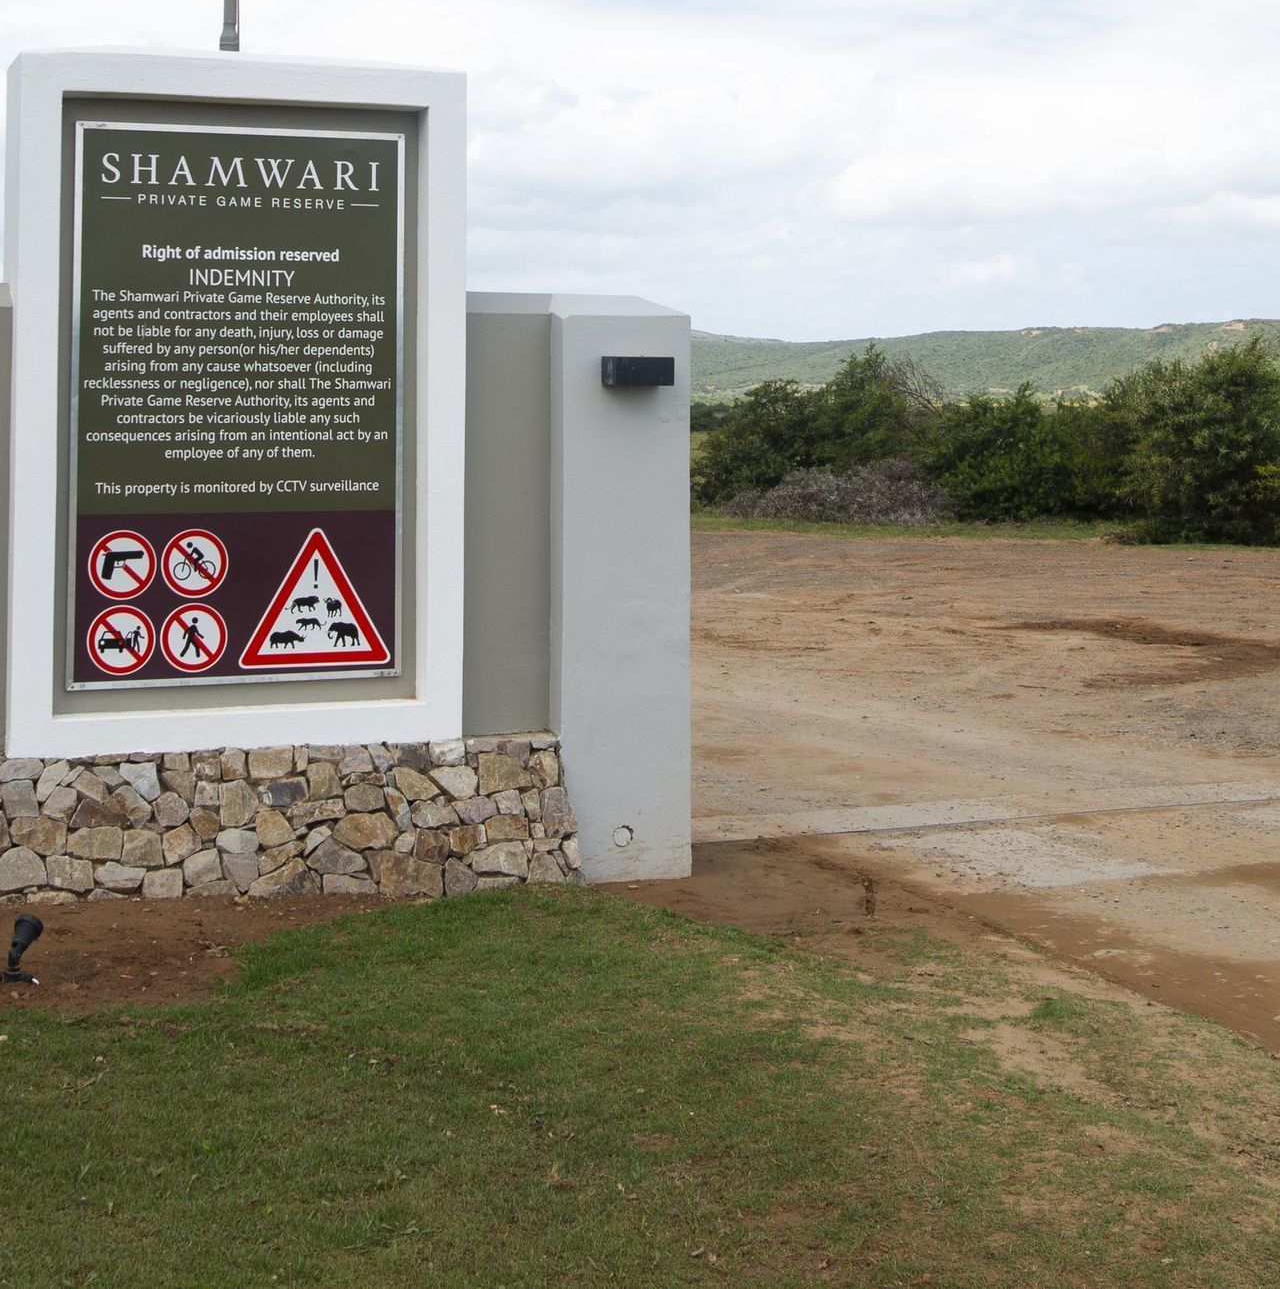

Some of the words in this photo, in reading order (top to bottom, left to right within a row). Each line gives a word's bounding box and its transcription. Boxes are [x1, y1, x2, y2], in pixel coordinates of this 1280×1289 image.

[101, 152, 380, 191] SHAMWARI
[138, 193, 207, 206] PRIVATE
[216, 196, 262, 208] GAME
[272, 197, 344, 210] RESERVE
[142, 244, 182, 262] Right
[185, 245, 201, 259] of
[203, 246, 276, 261] admission
[280, 248, 339, 262] reserved
[190, 268, 295, 287] INDEMNITY
[92, 289, 116, 302] The
[119, 289, 179, 302] Shamwari
[183, 291, 225, 303] Private
[228, 291, 262, 304] Game
[266, 292, 311, 304] Reserve
[313, 293, 369, 308] Authority,
[372, 294, 385, 305] its
[93, 309, 134, 322] agents
[137, 308, 160, 320] and
[164, 309, 231, 320] contractors
[234, 309, 257, 321] and
[260, 309, 288, 321] their
[291, 310, 353, 324] employees
[357, 310, 385, 322] shall
[94, 326, 114, 336] not
[118, 325, 133, 337] be
[137, 325, 171, 337] liable
[174, 325, 192, 337] for
[195, 328, 217, 340] any
[219, 326, 257, 339] death,
[259, 326, 294, 341] injury,
[296, 327, 319, 338] loss
[322, 329, 335, 338] or
[338, 327, 384, 342] damage
[103, 342, 153, 354] suffered
[157, 343, 171, 357] by
[173, 345, 196, 357] any
[199, 343, 255, 357] person(or
[259, 343, 300, 357] his/her
[303, 344, 375, 358] dependents)
[104, 359, 146, 374] arising
[150, 360, 178, 372] from
[182, 363, 204, 374] any
[206, 363, 241, 372] cause
[244, 360, 312, 372] whatsoever
[315, 361, 372, 375] (including
[84, 377, 160, 389] recklessness
[163, 380, 177, 389] or
[180, 377, 252, 392] negligence),
[255, 380, 275, 389] nor
[278, 378, 306, 389] shall
[309, 377, 331, 390] The
[335, 377, 391, 390] Shamwari
[101, 394, 143, 406] Private
[147, 394, 182, 406] Game
[186, 394, 232, 407] Reserve
[234, 395, 292, 409] Authority,
[294, 395, 308, 407] its
[311, 396, 350, 409] agents
[353, 395, 375, 406] and
[116, 413, 185, 424] contractors
[189, 412, 203, 424] be
[206, 412, 271, 426] vicariously
[274, 412, 307, 424] liable
[310, 414, 331, 426] any
[333, 412, 360, 423] such
[86, 432, 171, 444] consequences
[175, 429, 215, 444] arising
[219, 429, 247, 441] from
[251, 432, 265, 441] an
[269, 429, 333, 441] intentional
[336, 430, 354, 440] act
[358, 429, 371, 443] by
[374, 431, 388, 440] an
[165, 447, 224, 461] employee
[227, 446, 240, 458] of
[242, 449, 264, 461] any
[266, 446, 279, 458] of
[281, 446, 315, 458] them.
[95, 482, 121, 494] This
[125, 483, 178, 497] property
[180, 481, 190, 493] is
[194, 481, 256, 493] monitored
[259, 481, 274, 495] by
[276, 480, 307, 492] CCTV
[310, 479, 379, 492] surveillance
